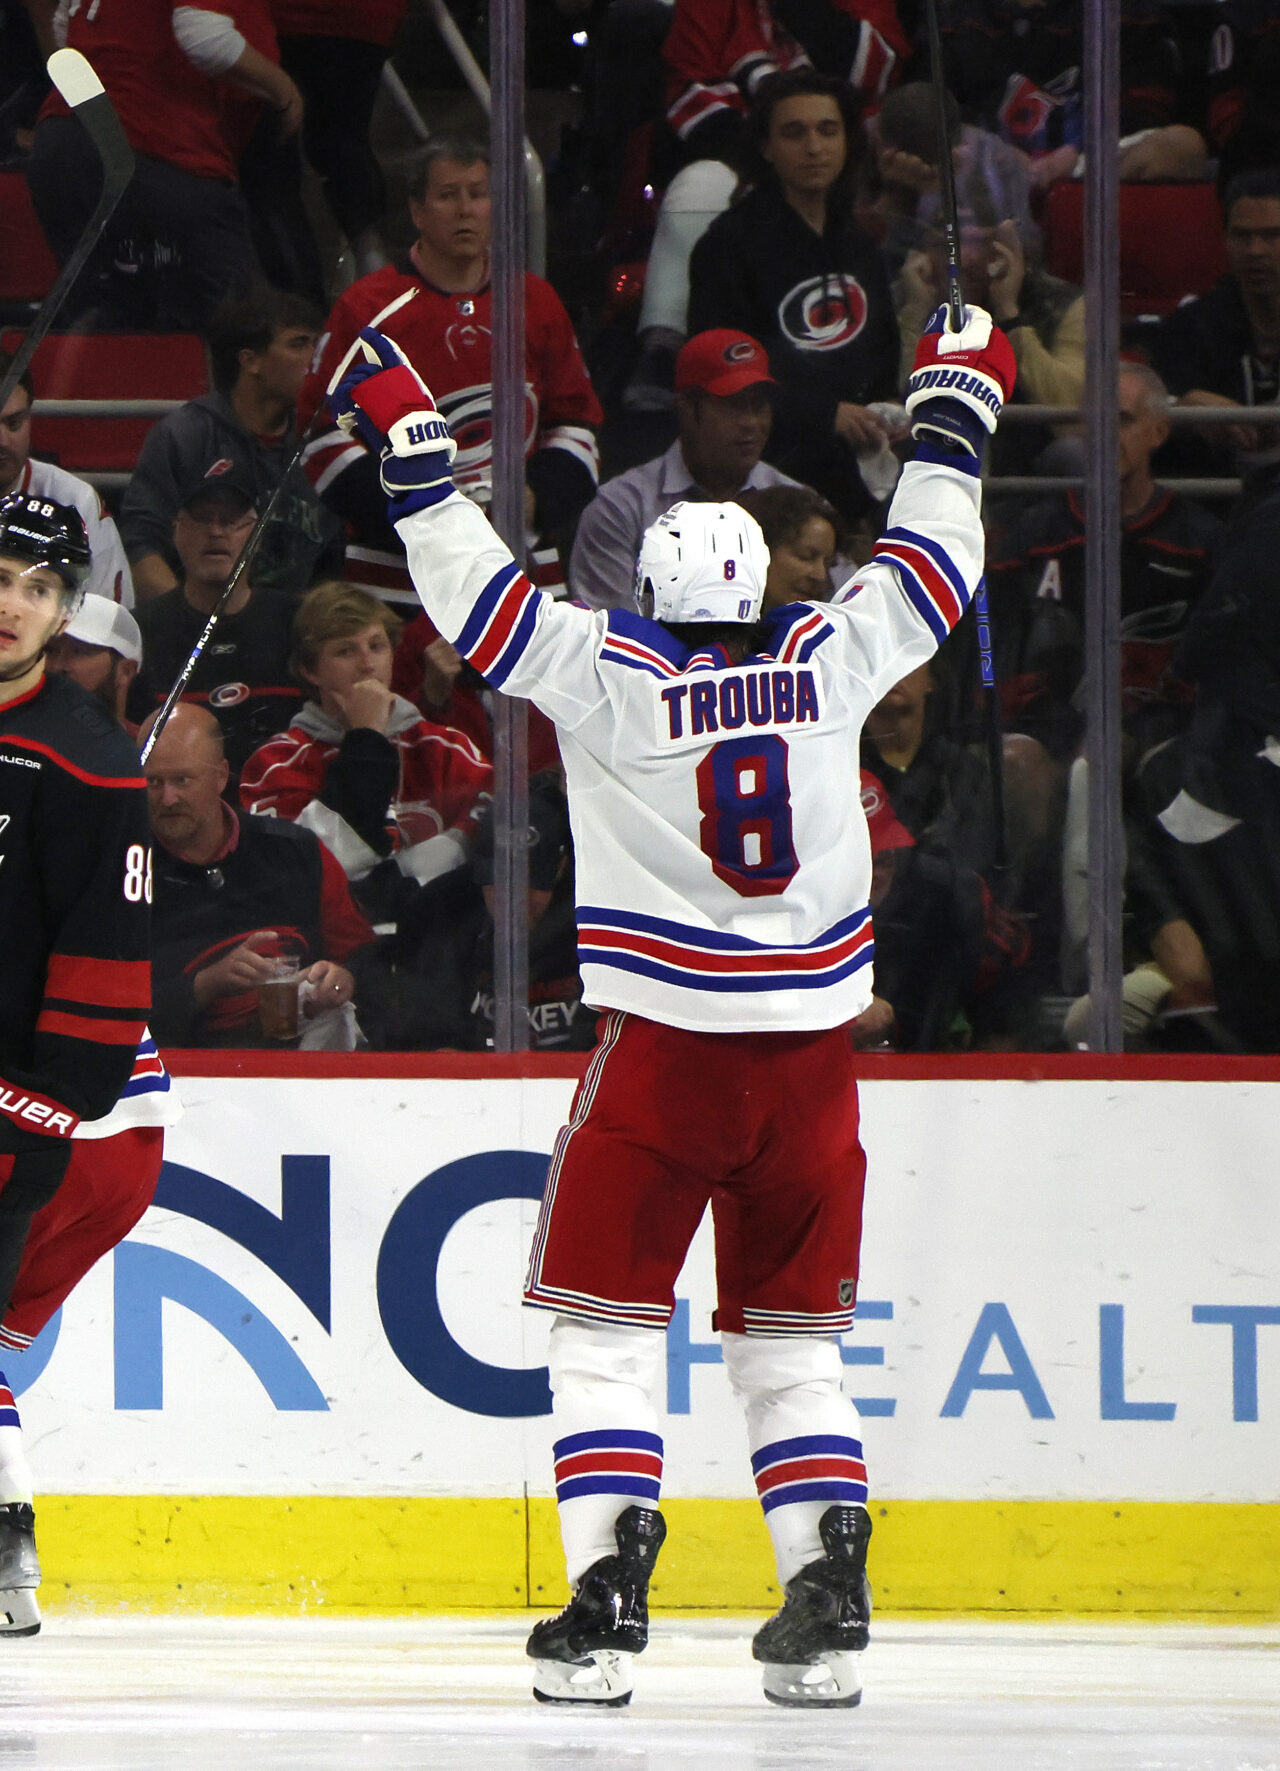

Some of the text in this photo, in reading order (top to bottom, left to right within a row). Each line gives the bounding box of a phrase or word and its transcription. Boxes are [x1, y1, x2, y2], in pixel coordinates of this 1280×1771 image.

[909, 368, 1004, 418] WARRIO
[26, 499, 55, 518] 88
[723, 559, 736, 581] 8
[1036, 557, 1063, 601] A
[661, 670, 820, 740] TROUBA
[695, 733, 801, 898] 8
